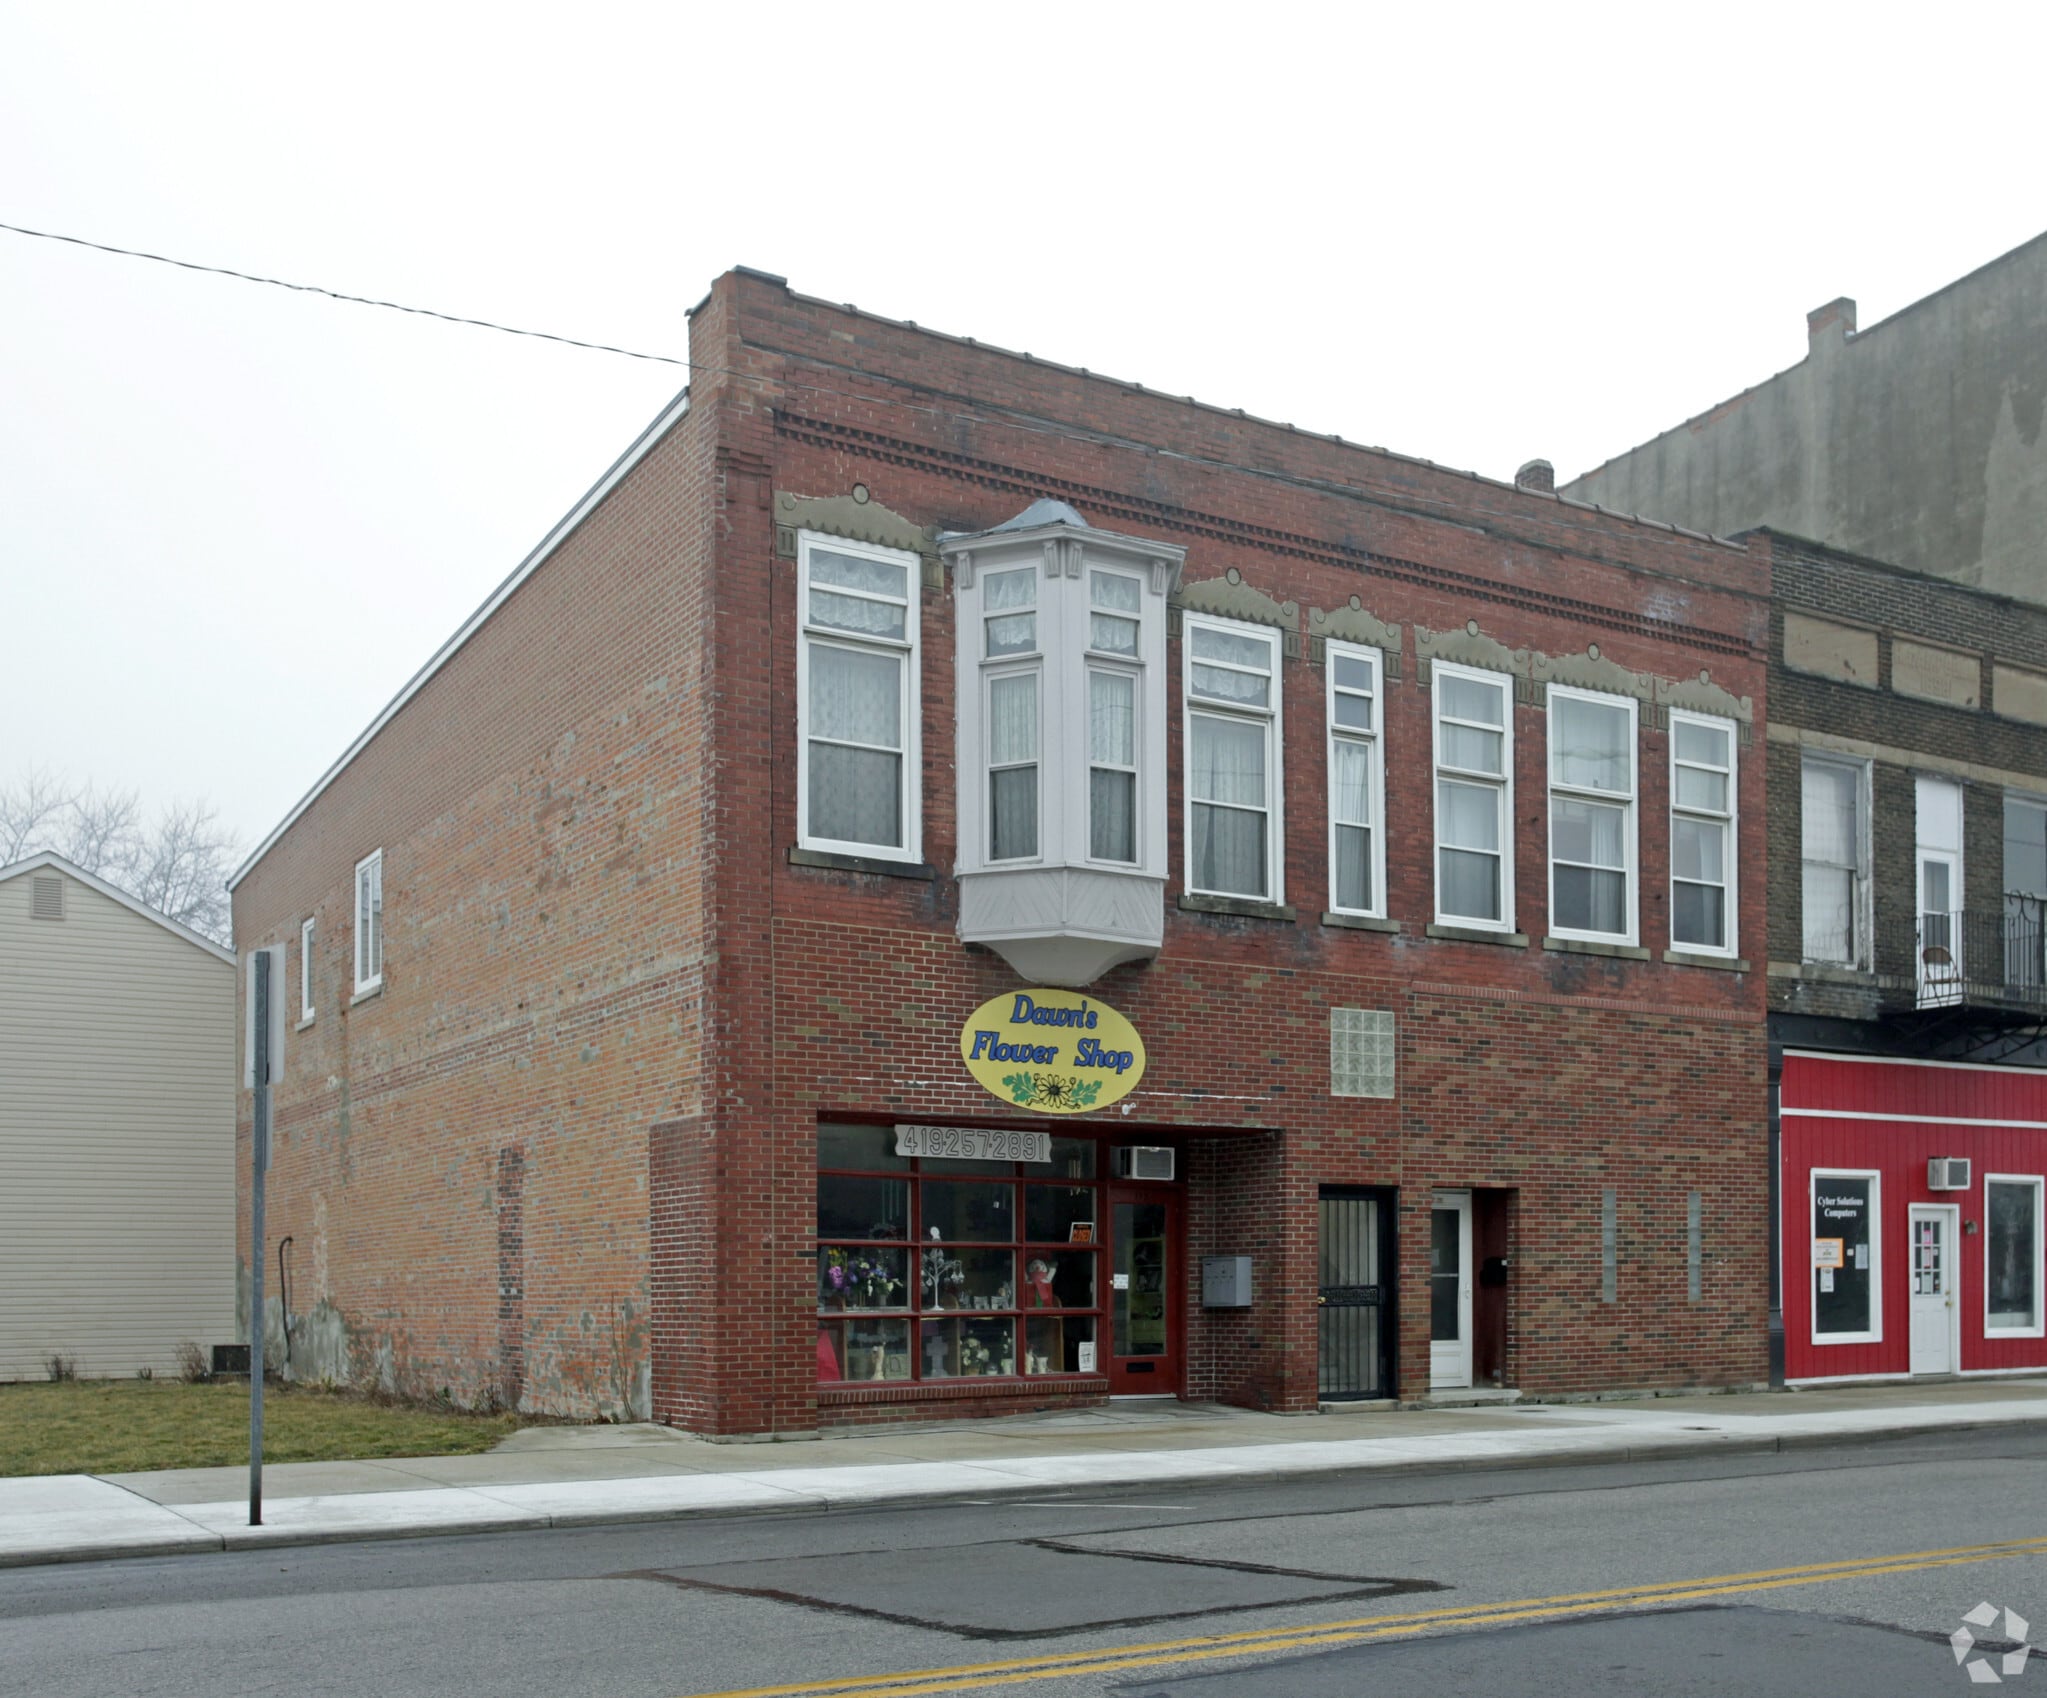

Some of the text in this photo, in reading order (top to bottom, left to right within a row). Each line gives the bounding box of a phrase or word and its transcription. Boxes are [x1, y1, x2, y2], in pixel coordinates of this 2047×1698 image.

[1010, 994, 1098, 1029] Dawn's
[969, 1030, 1134, 1075] Flower Shop
[1817, 1196, 1864, 1207] Cyber Solutions
[1824, 1207, 1857, 1219] Computers
